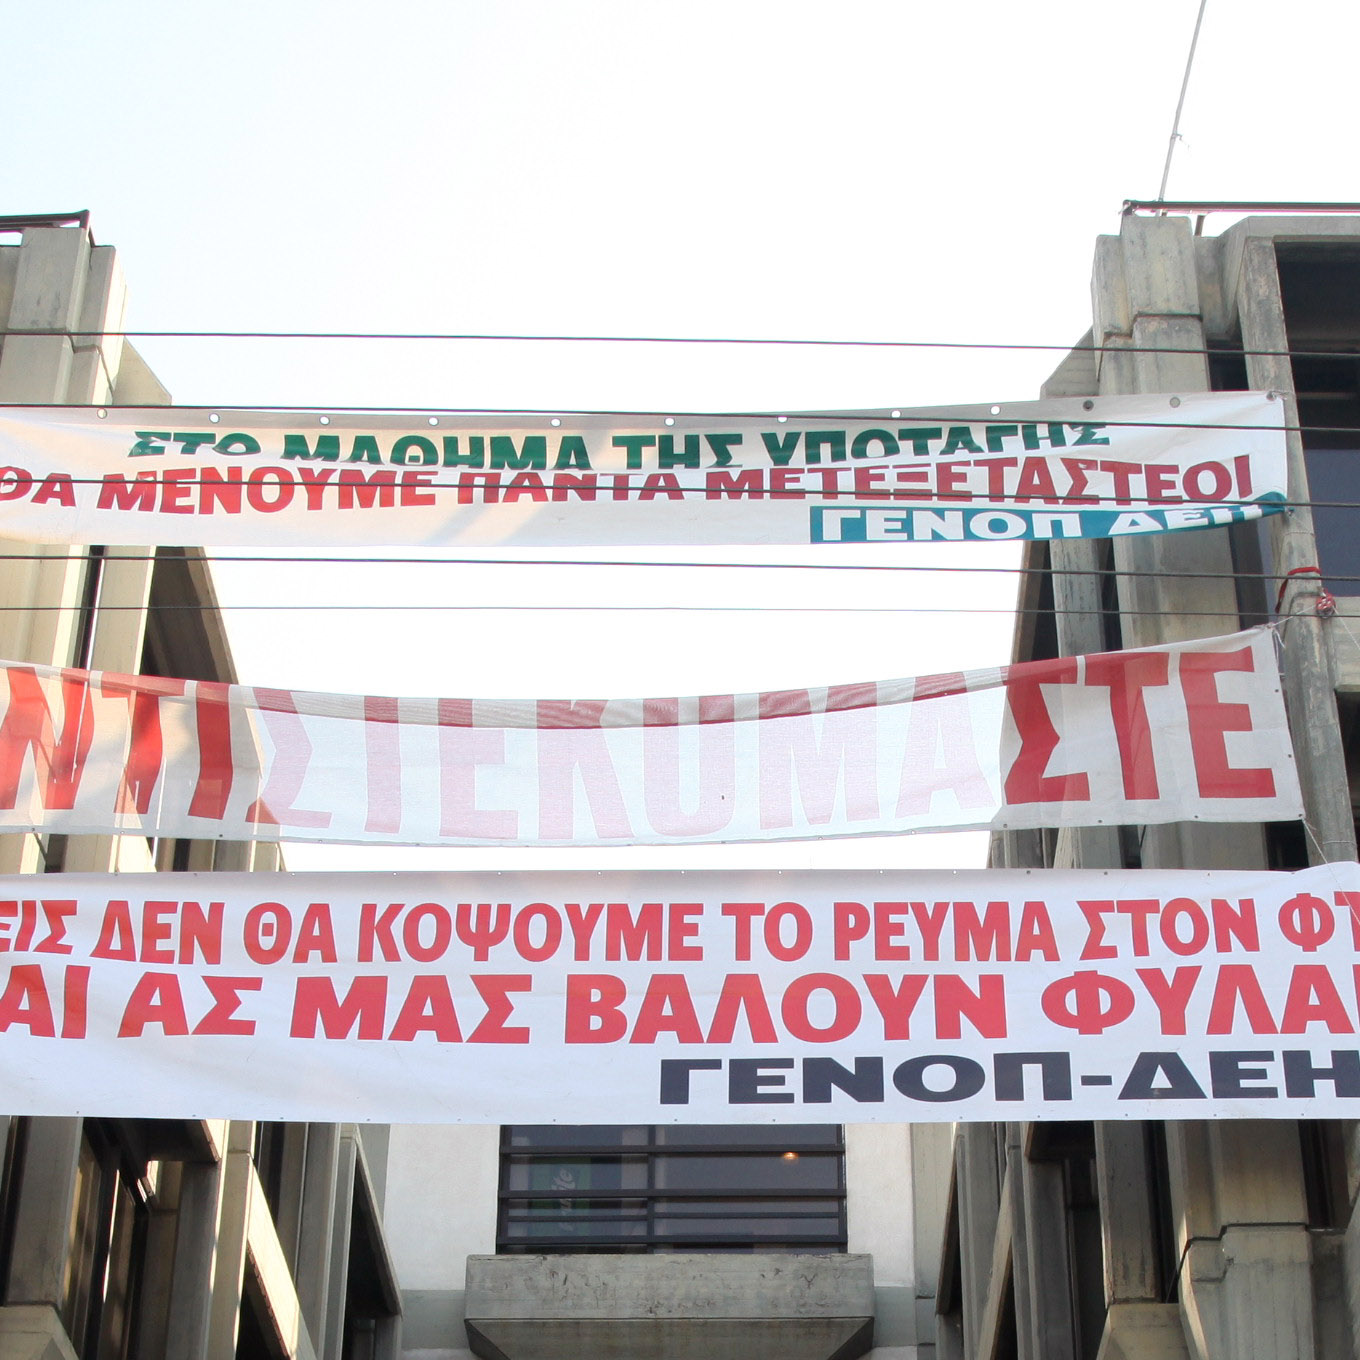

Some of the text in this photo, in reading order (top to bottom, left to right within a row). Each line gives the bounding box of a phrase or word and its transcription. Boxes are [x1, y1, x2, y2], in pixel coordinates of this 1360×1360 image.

[612, 433, 743, 468] ΤΗΣ
[761, 423, 1111, 466] ΥΠΟΤΑΓΗΣ
[96, 466, 437, 515] ΜΕΝΟΥΜΕ
[457, 472, 685, 505] ΠΑΝΤΑ
[823, 508, 1083, 542] ΓΕΝΟΠ
[90, 900, 225, 966] ΔΕΝ
[243, 901, 338, 965] ΘΑ
[357, 902, 705, 964] ΚΟΨΟΥΜΕ
[721, 901, 814, 962] ΤΟ
[833, 900, 1061, 963] ΡΕΥΜΑ
[1078, 896, 1260, 960] ΣΤΟΝ
[117, 971, 264, 1038] ΑΣ
[290, 973, 533, 1045] ΜΑΣ
[564, 972, 1008, 1044] ΒΑΛΟΥΝ
